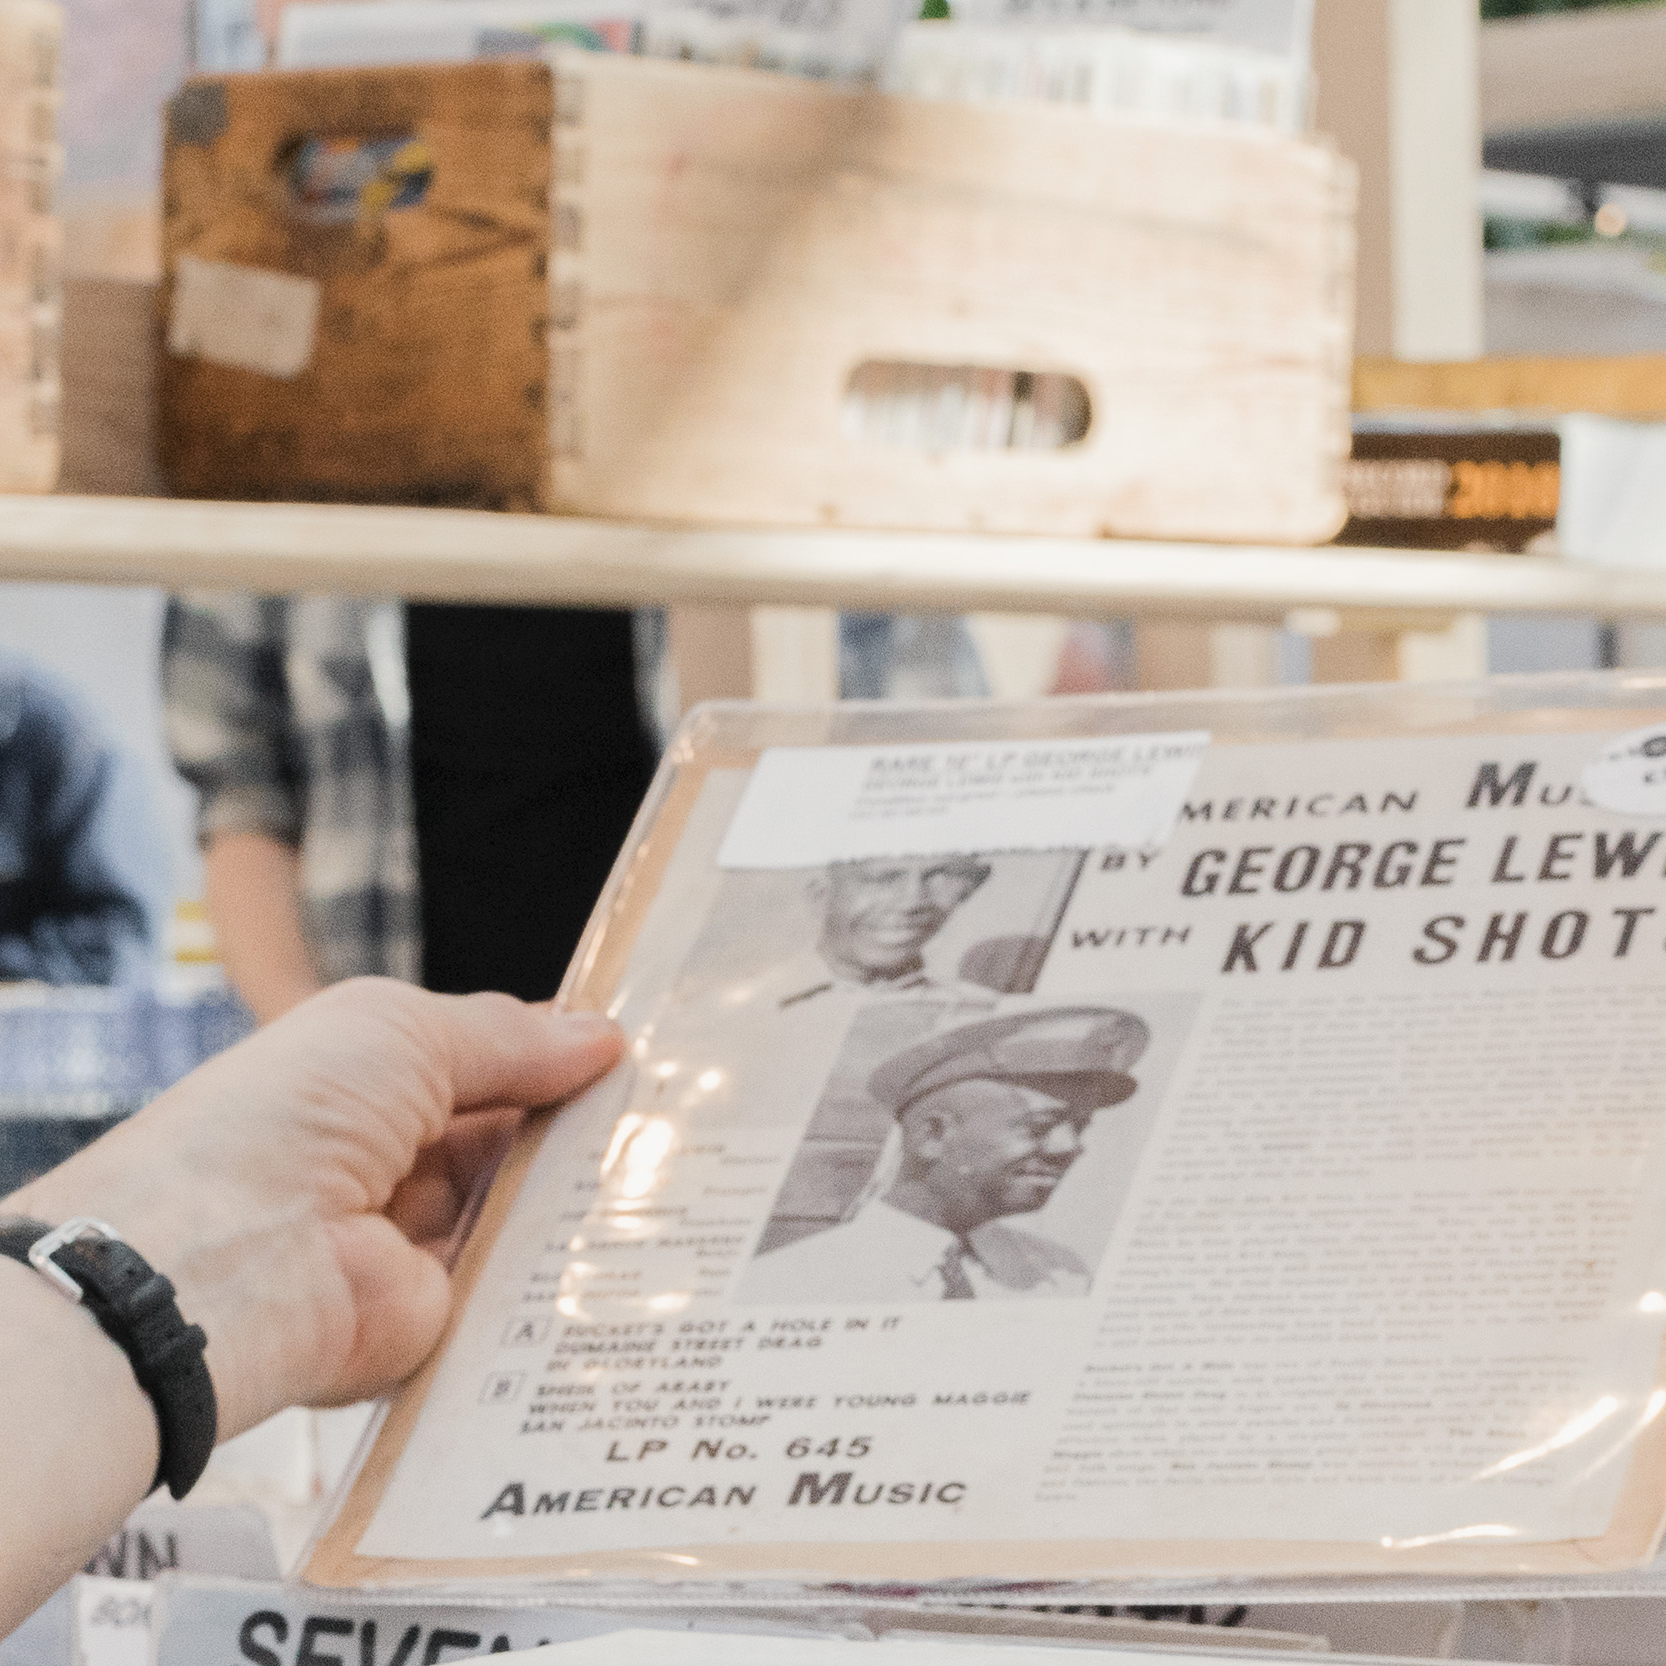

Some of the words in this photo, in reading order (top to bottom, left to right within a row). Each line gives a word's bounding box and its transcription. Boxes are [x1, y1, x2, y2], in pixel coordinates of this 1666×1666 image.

[1179, 790, 1420, 823] MERICAN
[1180, 838, 1467, 898] GEORGE
[1072, 926, 1191, 948] WITH
[1220, 919, 1367, 973] KID
[605, 1438, 669, 1463] LP
[691, 1438, 758, 1461] No.
[785, 1435, 874, 1460] 645
[480, 1481, 757, 1521] AMERICAN
[788, 1472, 969, 1507] MUSIC
